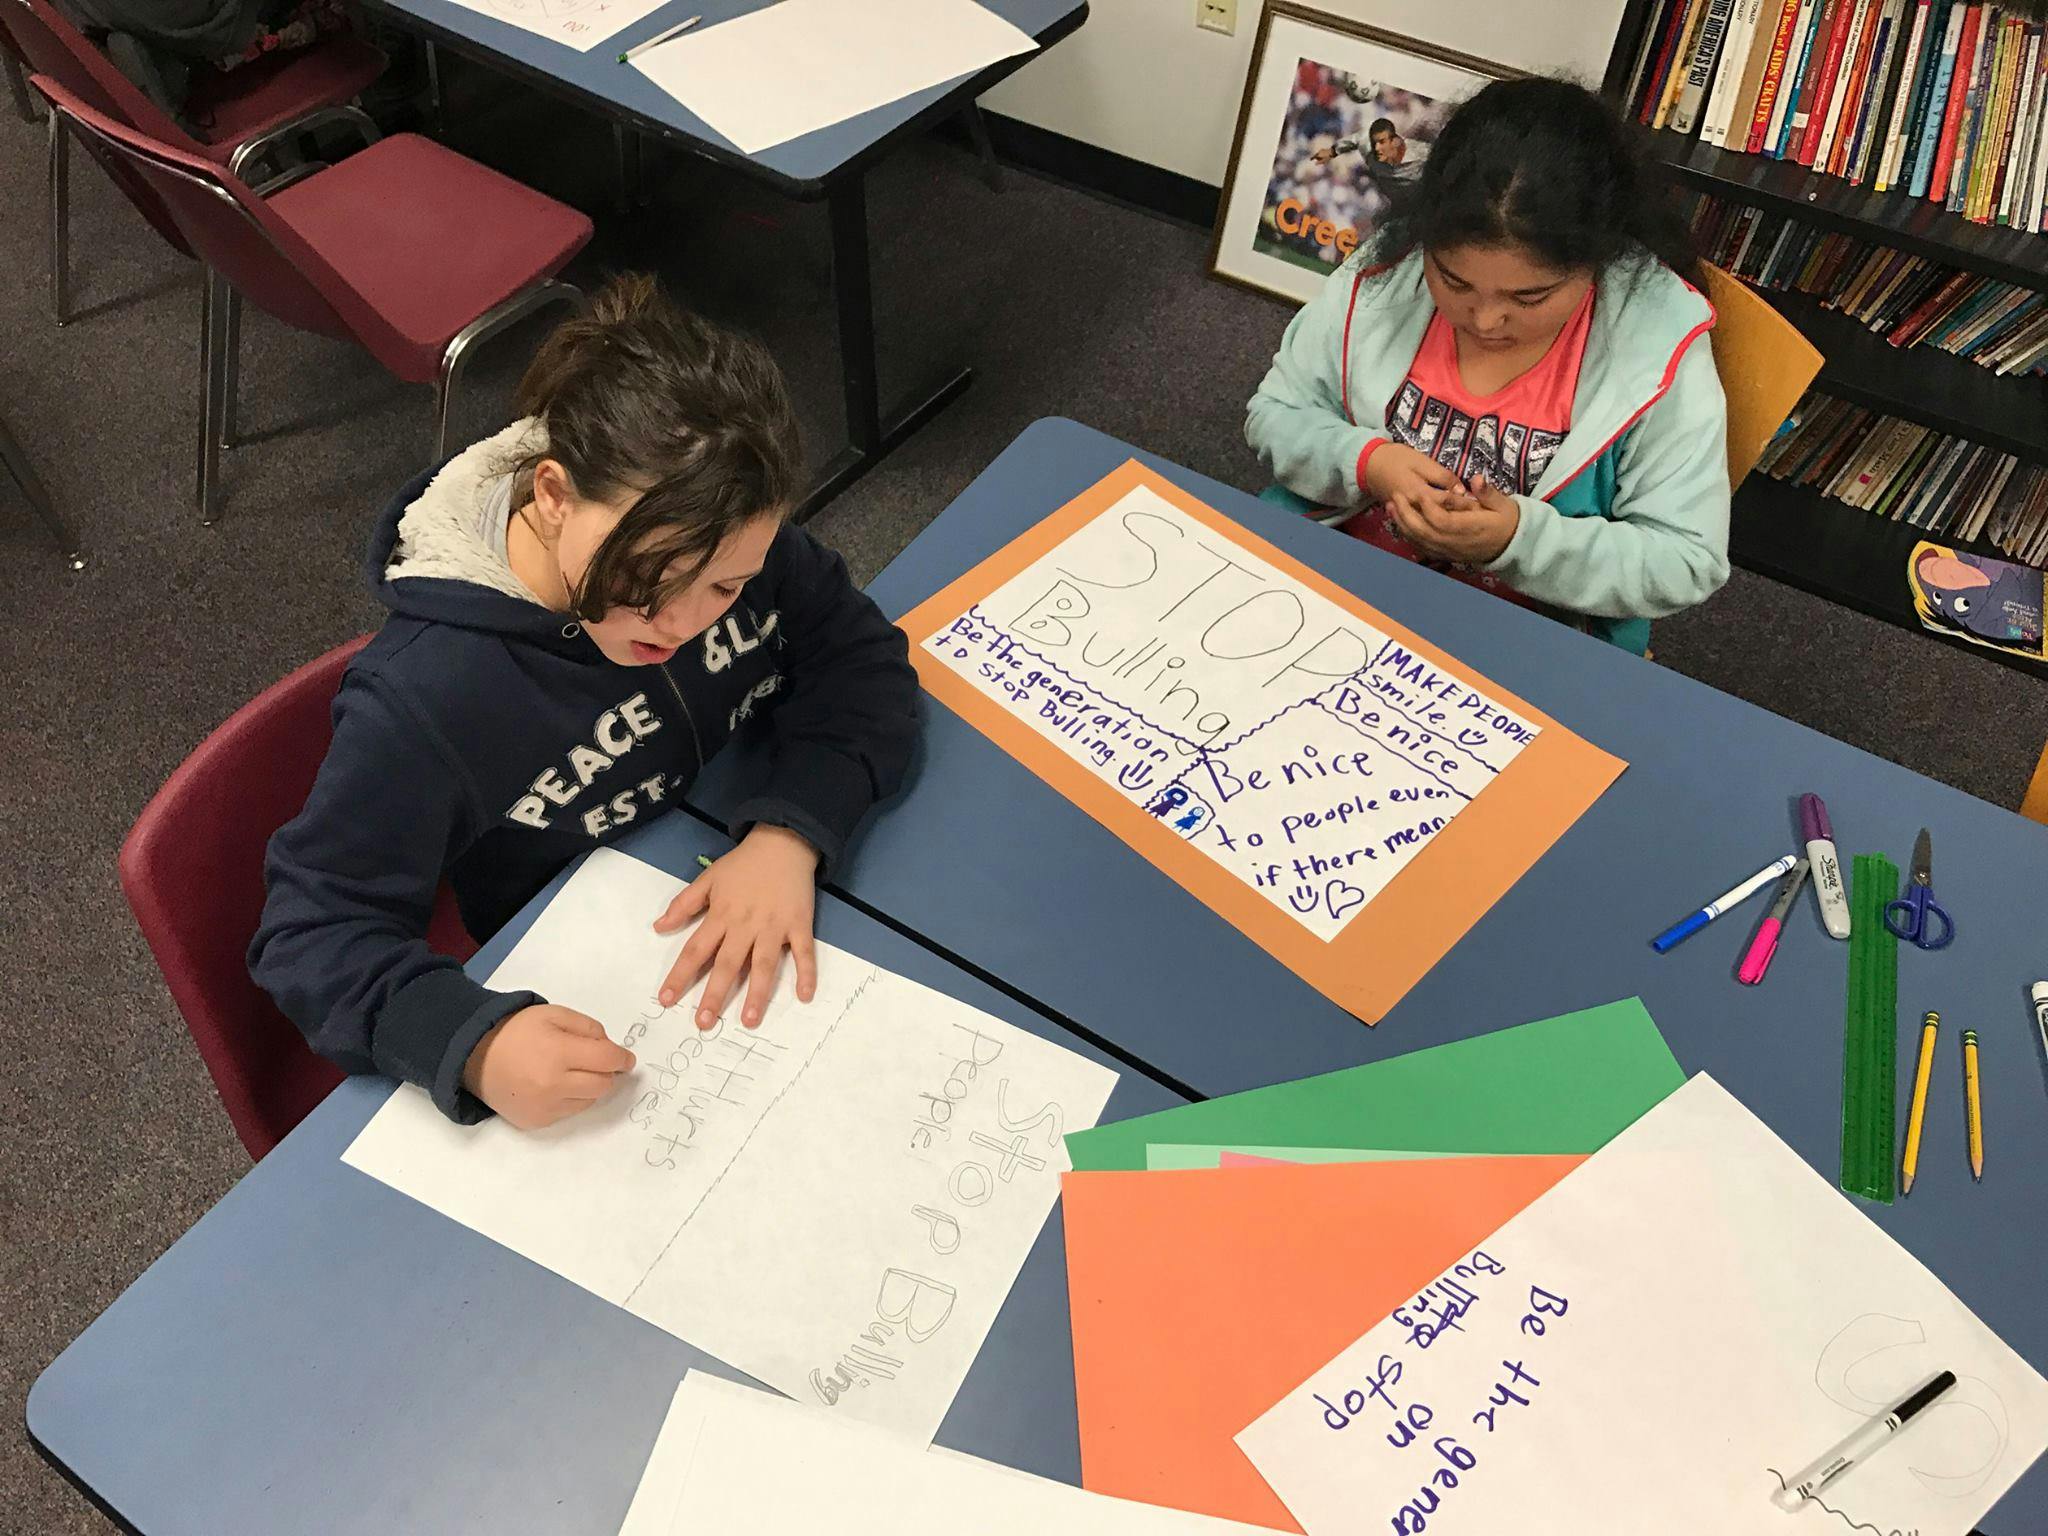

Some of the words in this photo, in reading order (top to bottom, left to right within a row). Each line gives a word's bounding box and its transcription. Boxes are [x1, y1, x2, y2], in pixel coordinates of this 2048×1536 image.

[1695, 17, 1724, 66] AMERICA'S
[1779, 15, 1791, 35] Book
[1688, 63, 1709, 87] PAST
[1768, 47, 1785, 80] KIDS'
[1756, 79, 1777, 123] CRAFTS
[1926, 69, 1950, 141] PLANET
[1056, 512, 1368, 687] STOP
[936, 635, 968, 659] to
[1008, 579, 1230, 756] Bulling
[1381, 647, 1462, 703] MAKE
[950, 617, 983, 644] Be
[988, 633, 1023, 671] the
[1019, 668, 1169, 763] generation
[506, 691, 663, 830] PEACE
[1335, 687, 1382, 729] Be
[1387, 734, 1459, 774] nice
[1203, 759, 1270, 802] Be
[1282, 745, 1373, 784] nice
[1216, 824, 1263, 852] to
[1280, 796, 1380, 843] people
[1389, 787, 1450, 804] even
[1251, 862, 1282, 887] if
[1293, 848, 1378, 881] there
[645, 1063, 755, 1170] Hurts
[1391, 1251, 1506, 1326] Bulling
[1520, 1285, 1568, 1337] Be
[808, 1267, 958, 1407] Bulling
[1313, 1354, 1403, 1430] stop
[1387, 1403, 1433, 1448] on
